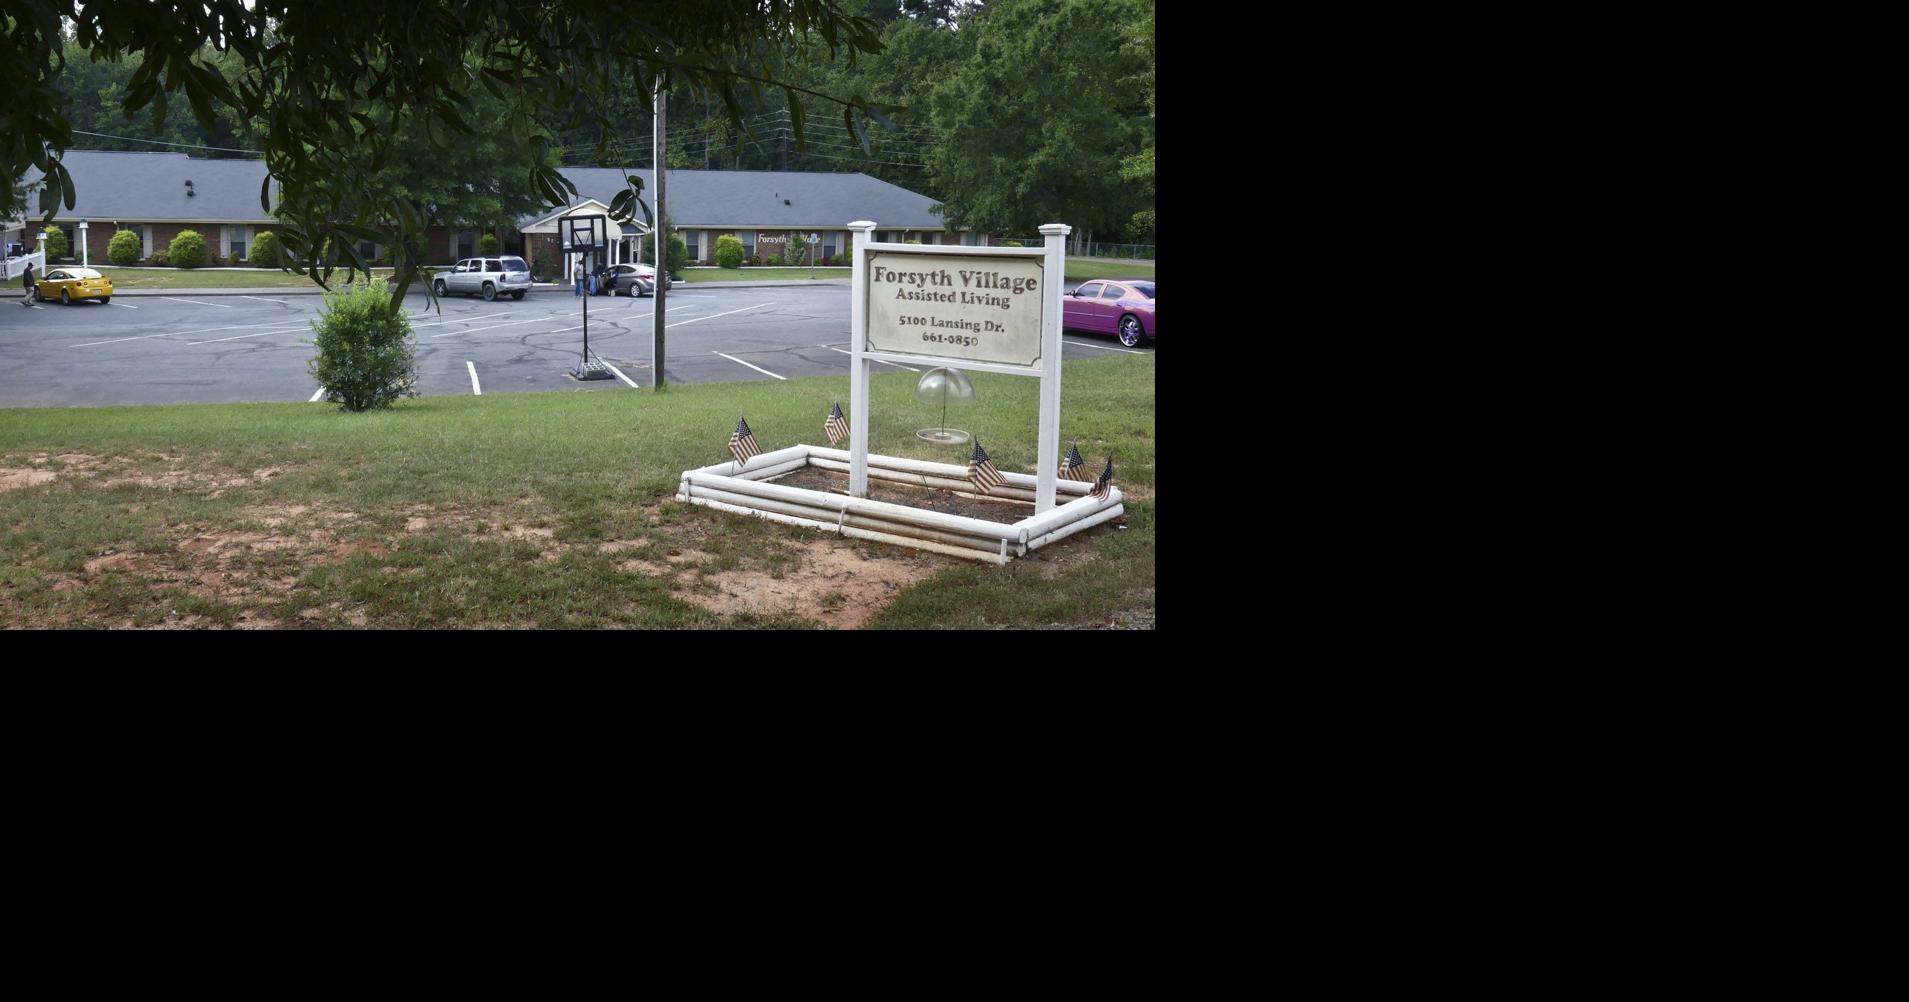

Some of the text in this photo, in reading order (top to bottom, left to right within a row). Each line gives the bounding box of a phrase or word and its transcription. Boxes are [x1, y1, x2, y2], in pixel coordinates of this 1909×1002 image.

[758, 233, 787, 244] Forsyth
[873, 266, 1038, 295] Forsyth Village
[896, 287, 1011, 310] Assisted Living
[899, 315, 1006, 333] 5100 Lansing Dr.
[922, 332, 979, 347] 661-0850
